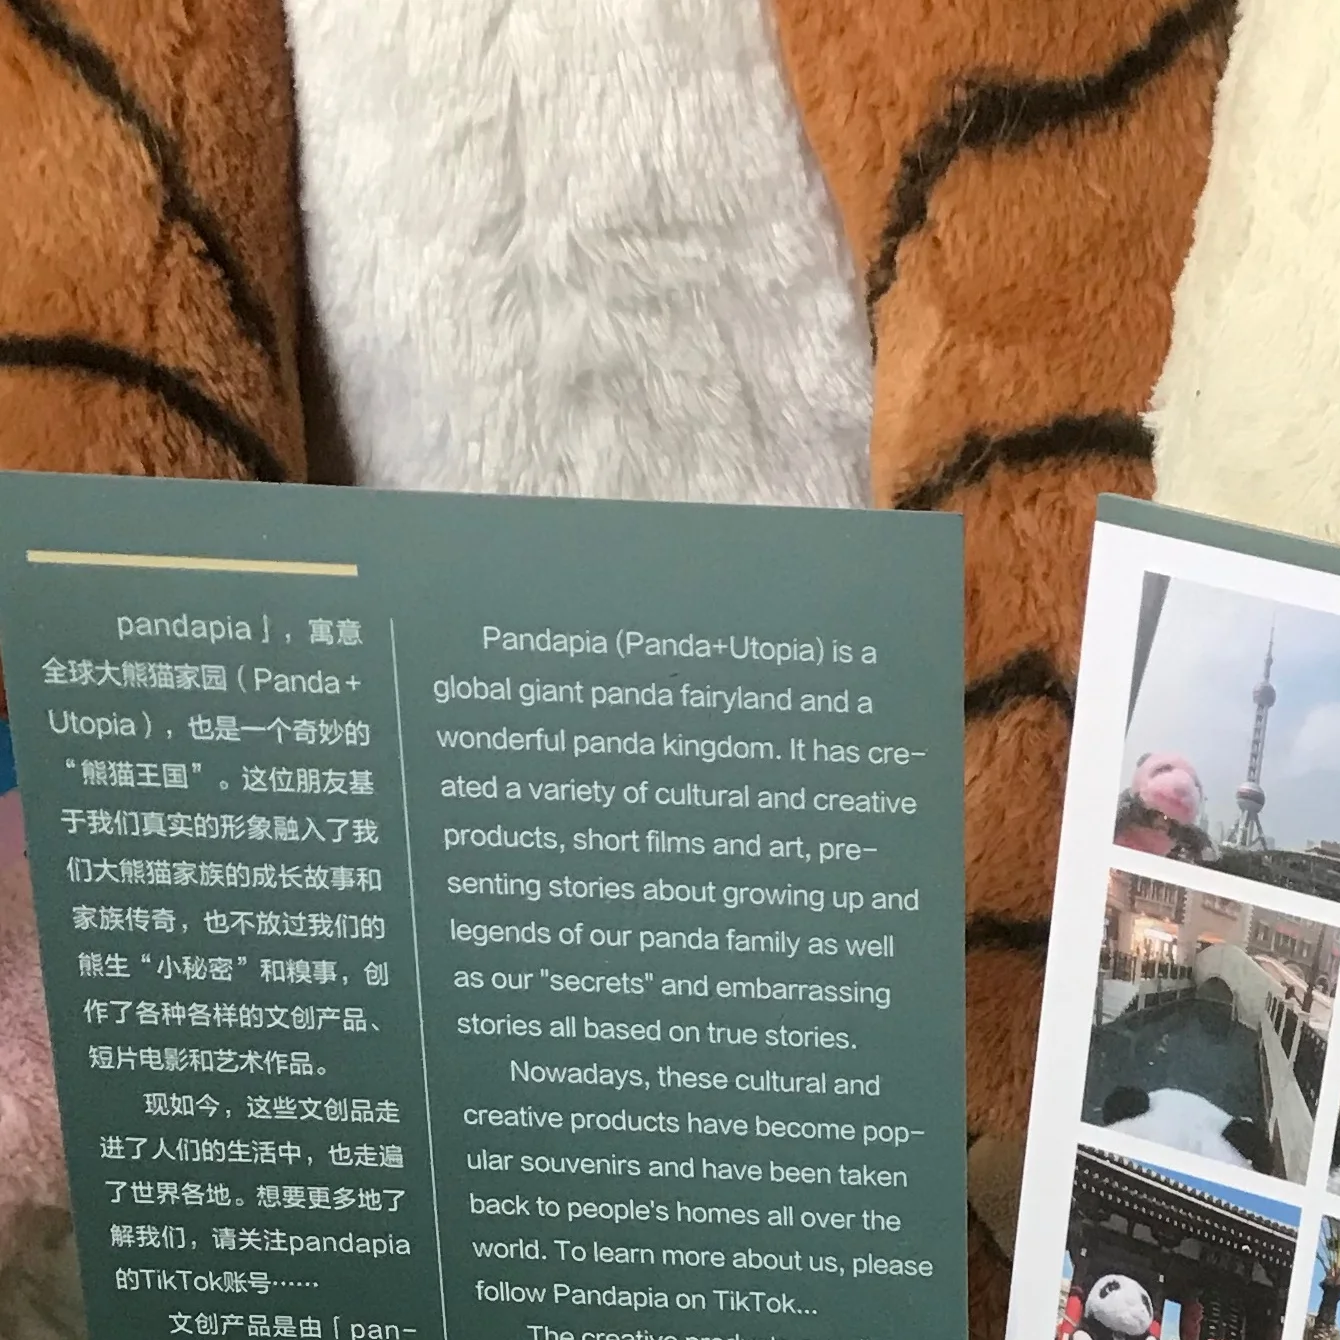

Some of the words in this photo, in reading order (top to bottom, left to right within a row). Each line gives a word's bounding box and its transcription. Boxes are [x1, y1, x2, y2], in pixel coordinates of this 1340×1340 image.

[482, 625, 608, 658] Pandapia
[615, 628, 825, 667] (Panda+Utopia)
[832, 639, 854, 664] is
[860, 645, 877, 665] a
[433, 674, 512, 704] global
[518, 677, 585, 707] giant
[590, 682, 674, 709] panda
[679, 682, 793, 714] fairyland
[799, 689, 850, 714] and
[856, 695, 873, 715] a
[435, 726, 567, 753] wonderful
[573, 731, 656, 758] panda
[662, 732, 782, 763] kingdom.
[790, 737, 807, 762] It
[813, 738, 861, 764] has
[440, 775, 498, 799] ated
[505, 781, 522, 800] a
[528, 778, 616, 808] variety
[623, 780, 649, 804] of
[654, 782, 750, 809] cultural
[757, 786, 807, 810] and
[813, 790, 918, 815] creative
[447, 872, 542, 902] senting
[548, 875, 636, 901] stories
[642, 877, 717, 903] about
[722, 882, 825, 913] growing
[832, 890, 865, 914] up
[871, 888, 920, 912] and
[450, 918, 552, 947] legends
[558, 922, 585, 945] of
[589, 928, 633, 947] our
[639, 926, 720, 953] panda
[725, 928, 801, 959] family
[807, 936, 839, 956] as
[844, 934, 895, 958] well
[453, 970, 485, 989] as
[490, 971, 534, 990] our
[539, 967, 654, 995] "secrets"
[661, 974, 709, 997] and
[715, 976, 891, 1010] embarrassing
[457, 1012, 543, 1037] stories
[549, 1015, 577, 1038] all
[583, 1016, 662, 1042] based
[668, 1025, 701, 1043] on
[706, 1021, 758, 1046] true
[764, 1024, 857, 1050] stories.
[510, 1059, 650, 1091] Nowadays,
[656, 1064, 729, 1090] these
[735, 1069, 827, 1094] cultural
[833, 1074, 881, 1097] and
[466, 1148, 514, 1171] ular
[520, 1153, 641, 1176] souvenirs
[648, 1156, 695, 1179] and
[701, 1157, 763, 1182] have
[769, 1160, 832, 1185] been
[837, 1163, 908, 1188] taken
[469, 1191, 531, 1216] back
[535, 1196, 561, 1218] to
[567, 1198, 670, 1224] people's
[676, 1200, 761, 1226] homes
[767, 1205, 794, 1227] all
[800, 1211, 857, 1230] over
[861, 1209, 902, 1232] the
[471, 1237, 547, 1261] world.
[553, 1239, 587, 1262] To
[593, 1240, 655, 1265] learn
[662, 1249, 726, 1268] more
[732, 1247, 804, 1272] about
[808, 1255, 845, 1277] us,
[852, 1252, 934, 1278] please
[474, 1279, 547, 1303] follow
[553, 1283, 669, 1312] Pandapia
[675, 1292, 707, 1310] on
[712, 1289, 818, 1315] TikTok...
